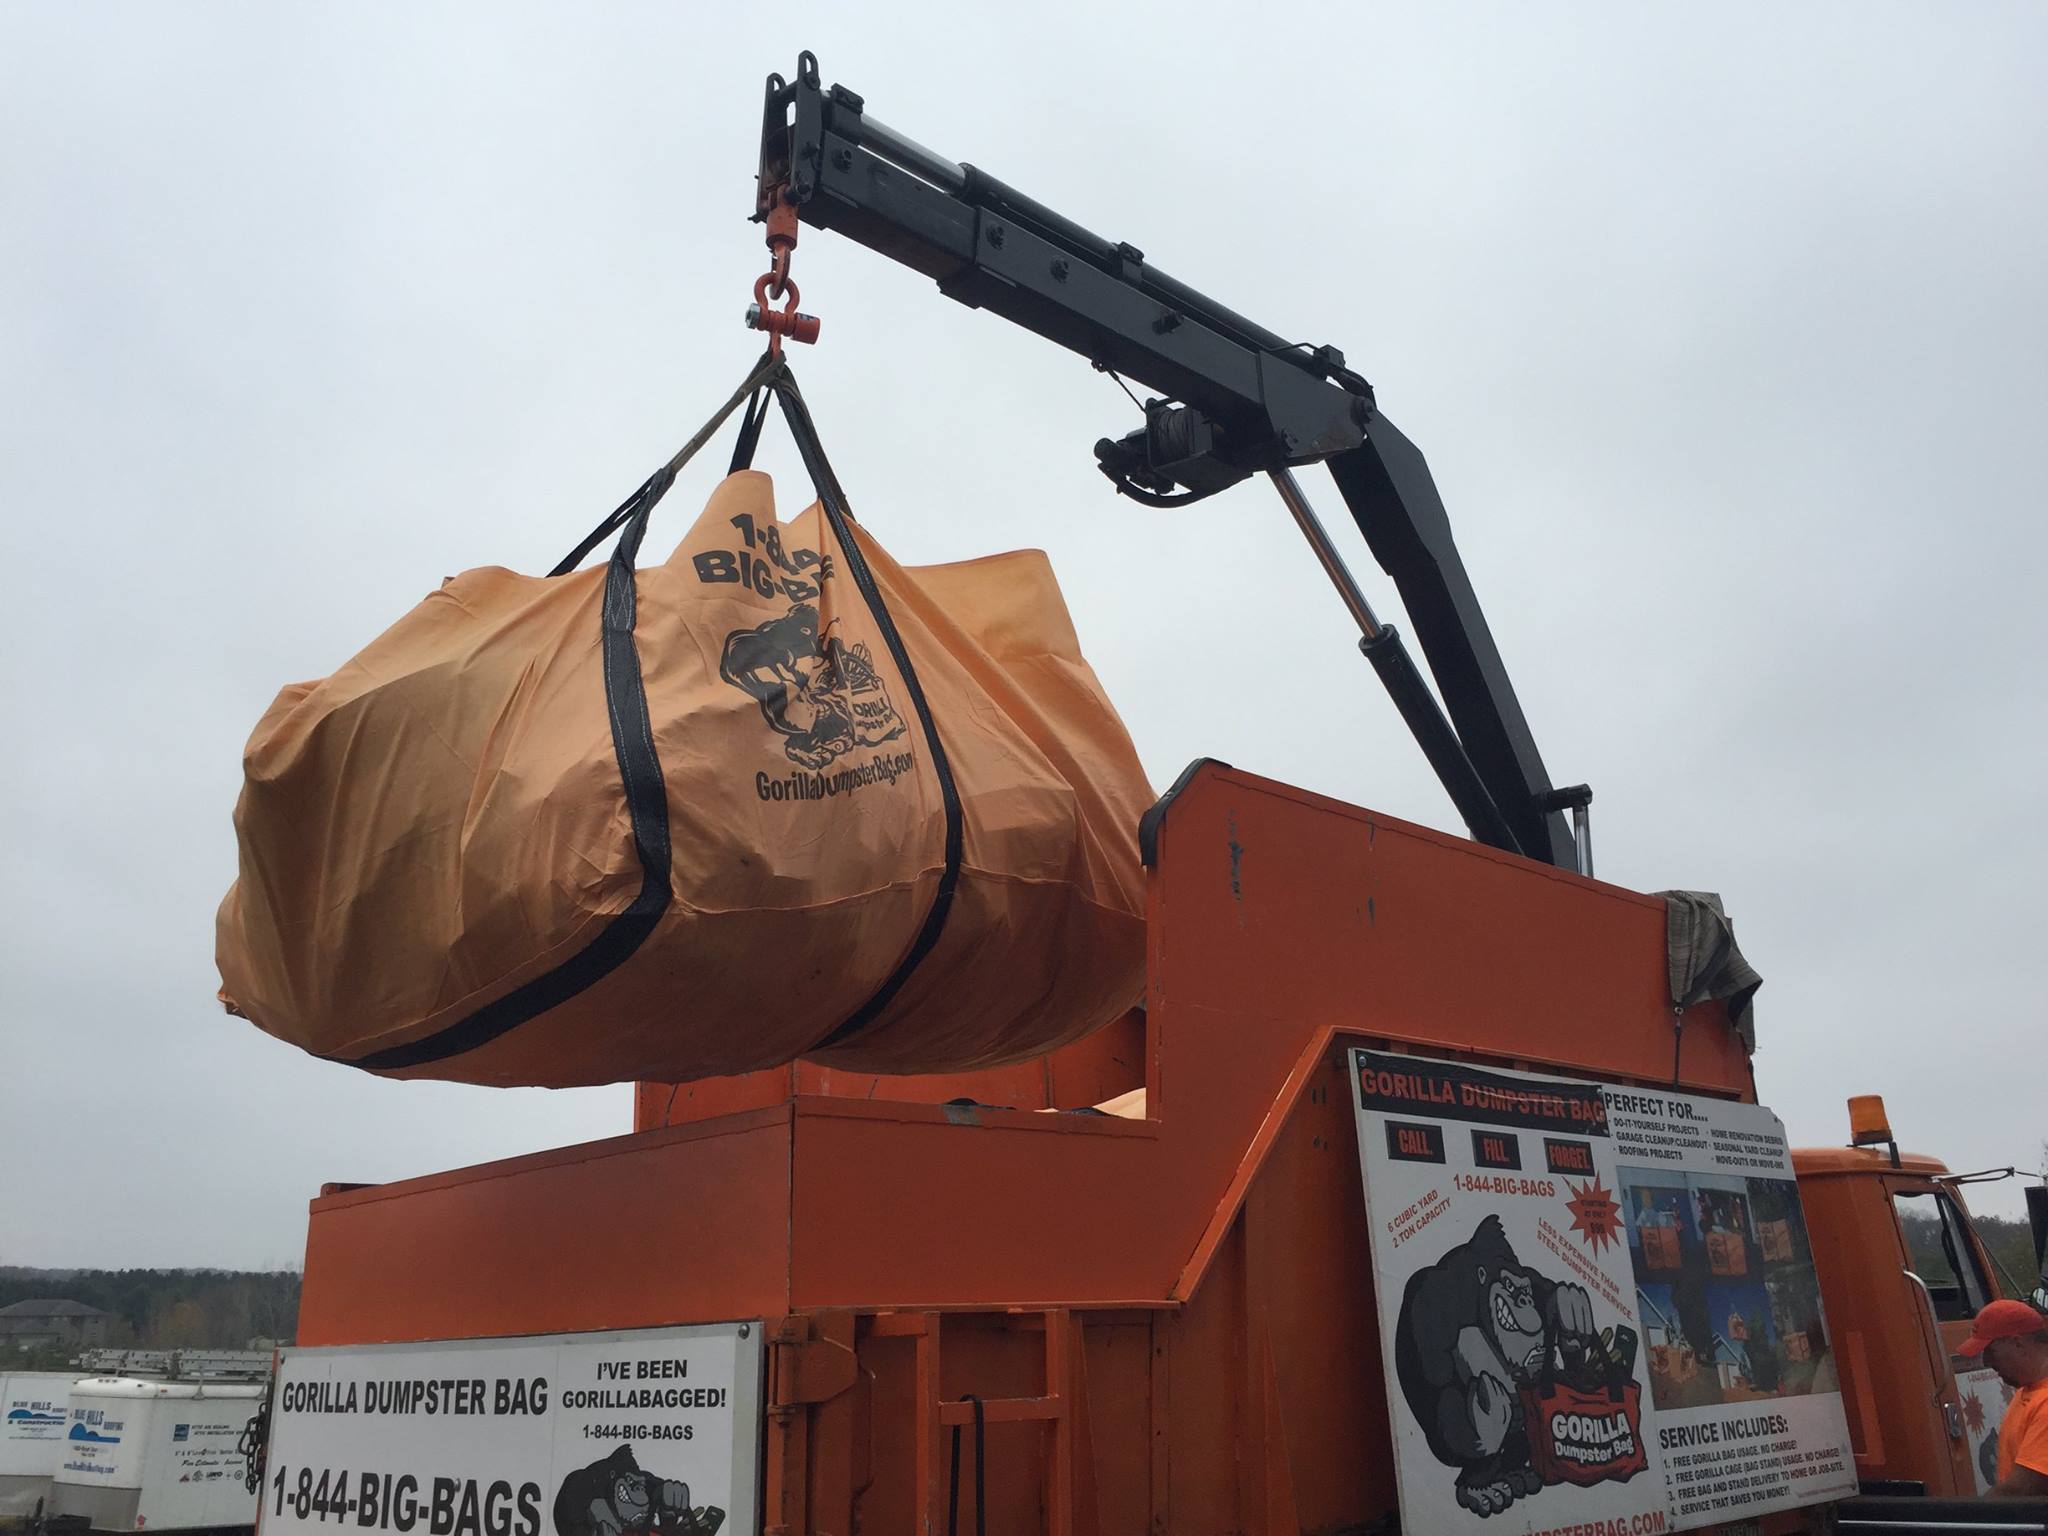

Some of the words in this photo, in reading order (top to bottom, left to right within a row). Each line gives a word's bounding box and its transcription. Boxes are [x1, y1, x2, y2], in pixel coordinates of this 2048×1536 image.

[1361, 1069, 1456, 1104] GORILLA
[1461, 1083, 1566, 1118] DUMPSTER
[1570, 1097, 1605, 1122] BAG
[1604, 1093, 1663, 1116] PERFECT
[1614, 1118, 1666, 1131] DO-IT-YOURSELF
[1668, 1125, 1699, 1135] PROJECTS
[1616, 1132, 1644, 1142] GARAGE
[1729, 1132, 1763, 1144] RENOVATION
[1619, 1146, 1649, 1157] ROOFING
[1650, 1150, 1683, 1160] PROJECTS
[1713, 1143, 1743, 1153] SEASONAL
[1744, 1146, 1759, 1155] YARD
[1760, 1148, 1783, 1157] CLEANUP
[1750, 1158, 1758, 1167] OR
[1453, 1174, 1555, 1197] 1-844-BIG-BAGS
[1387, 1223, 1393, 1233] 6
[1394, 1208, 1418, 1228] CUBIC
[1417, 1190, 1438, 1209] YARD
[1392, 1237, 1399, 1248] 2
[1399, 1227, 1416, 1244] TON
[1416, 1198, 1450, 1233] CAPACITY
[1537, 1231, 1560, 1256] STEEL
[1562, 1252, 1600, 1292] DUMPSTER
[1539, 1217, 1557, 1238] LESS
[1559, 1233, 1599, 1275] EXPENSIVE
[1601, 1272, 1620, 1295] THAN
[597, 1362, 630, 1380] I'VE
[637, 1360, 687, 1379] BEEN
[282, 1382, 358, 1414] GORILLA
[364, 1380, 486, 1415] DUMPSTER
[494, 1377, 548, 1416] BAG
[562, 1388, 726, 1408] GORILLABAGGED!
[583, 1424, 693, 1440] 1-844-BIG-BAGS
[1552, 1413, 1631, 1443] GORILLA
[1660, 1423, 1719, 1449] SERVICE
[1722, 1415, 1788, 1441] INCLUDES:
[1555, 1442, 1612, 1463] Dumpster
[1615, 1436, 1634, 1455] Bag
[1673, 1456, 1691, 1468] FREE
[1692, 1451, 1721, 1464] GORILLA
[1722, 1448, 1735, 1460] BAG
[1761, 1444, 1769, 1454] NO
[1676, 1471, 1694, 1483] FREE
[1695, 1466, 1724, 1480] GORILLA
[1725, 1463, 1743, 1474] CAGE
[1744, 1460, 1758, 1472] (BAG
[1760, 1456, 1782, 1469] STAND)
[1805, 1452, 1814, 1462] NO
[1678, 1487, 1696, 1499] FREE
[1697, 1484, 1712, 1496] BAG
[1713, 1481, 1727, 1492] AND
[1728, 1477, 1749, 1490] STAND
[1751, 1473, 1780, 1487] DELIVERY
[1781, 1471, 1790, 1480] TO
[1791, 1468, 1808, 1480] HOME
[1809, 1466, 1817, 1476] OR
[274, 1466, 542, 1536] 1-844-BIG-BAGS
[1681, 1502, 1710, 1515] SERVICE
[1711, 1498, 1729, 1510] THAT
[1730, 1493, 1750, 1506] SAVES
[1752, 1490, 1765, 1502] YOU
[1766, 1486, 1790, 1499] MONEY!
